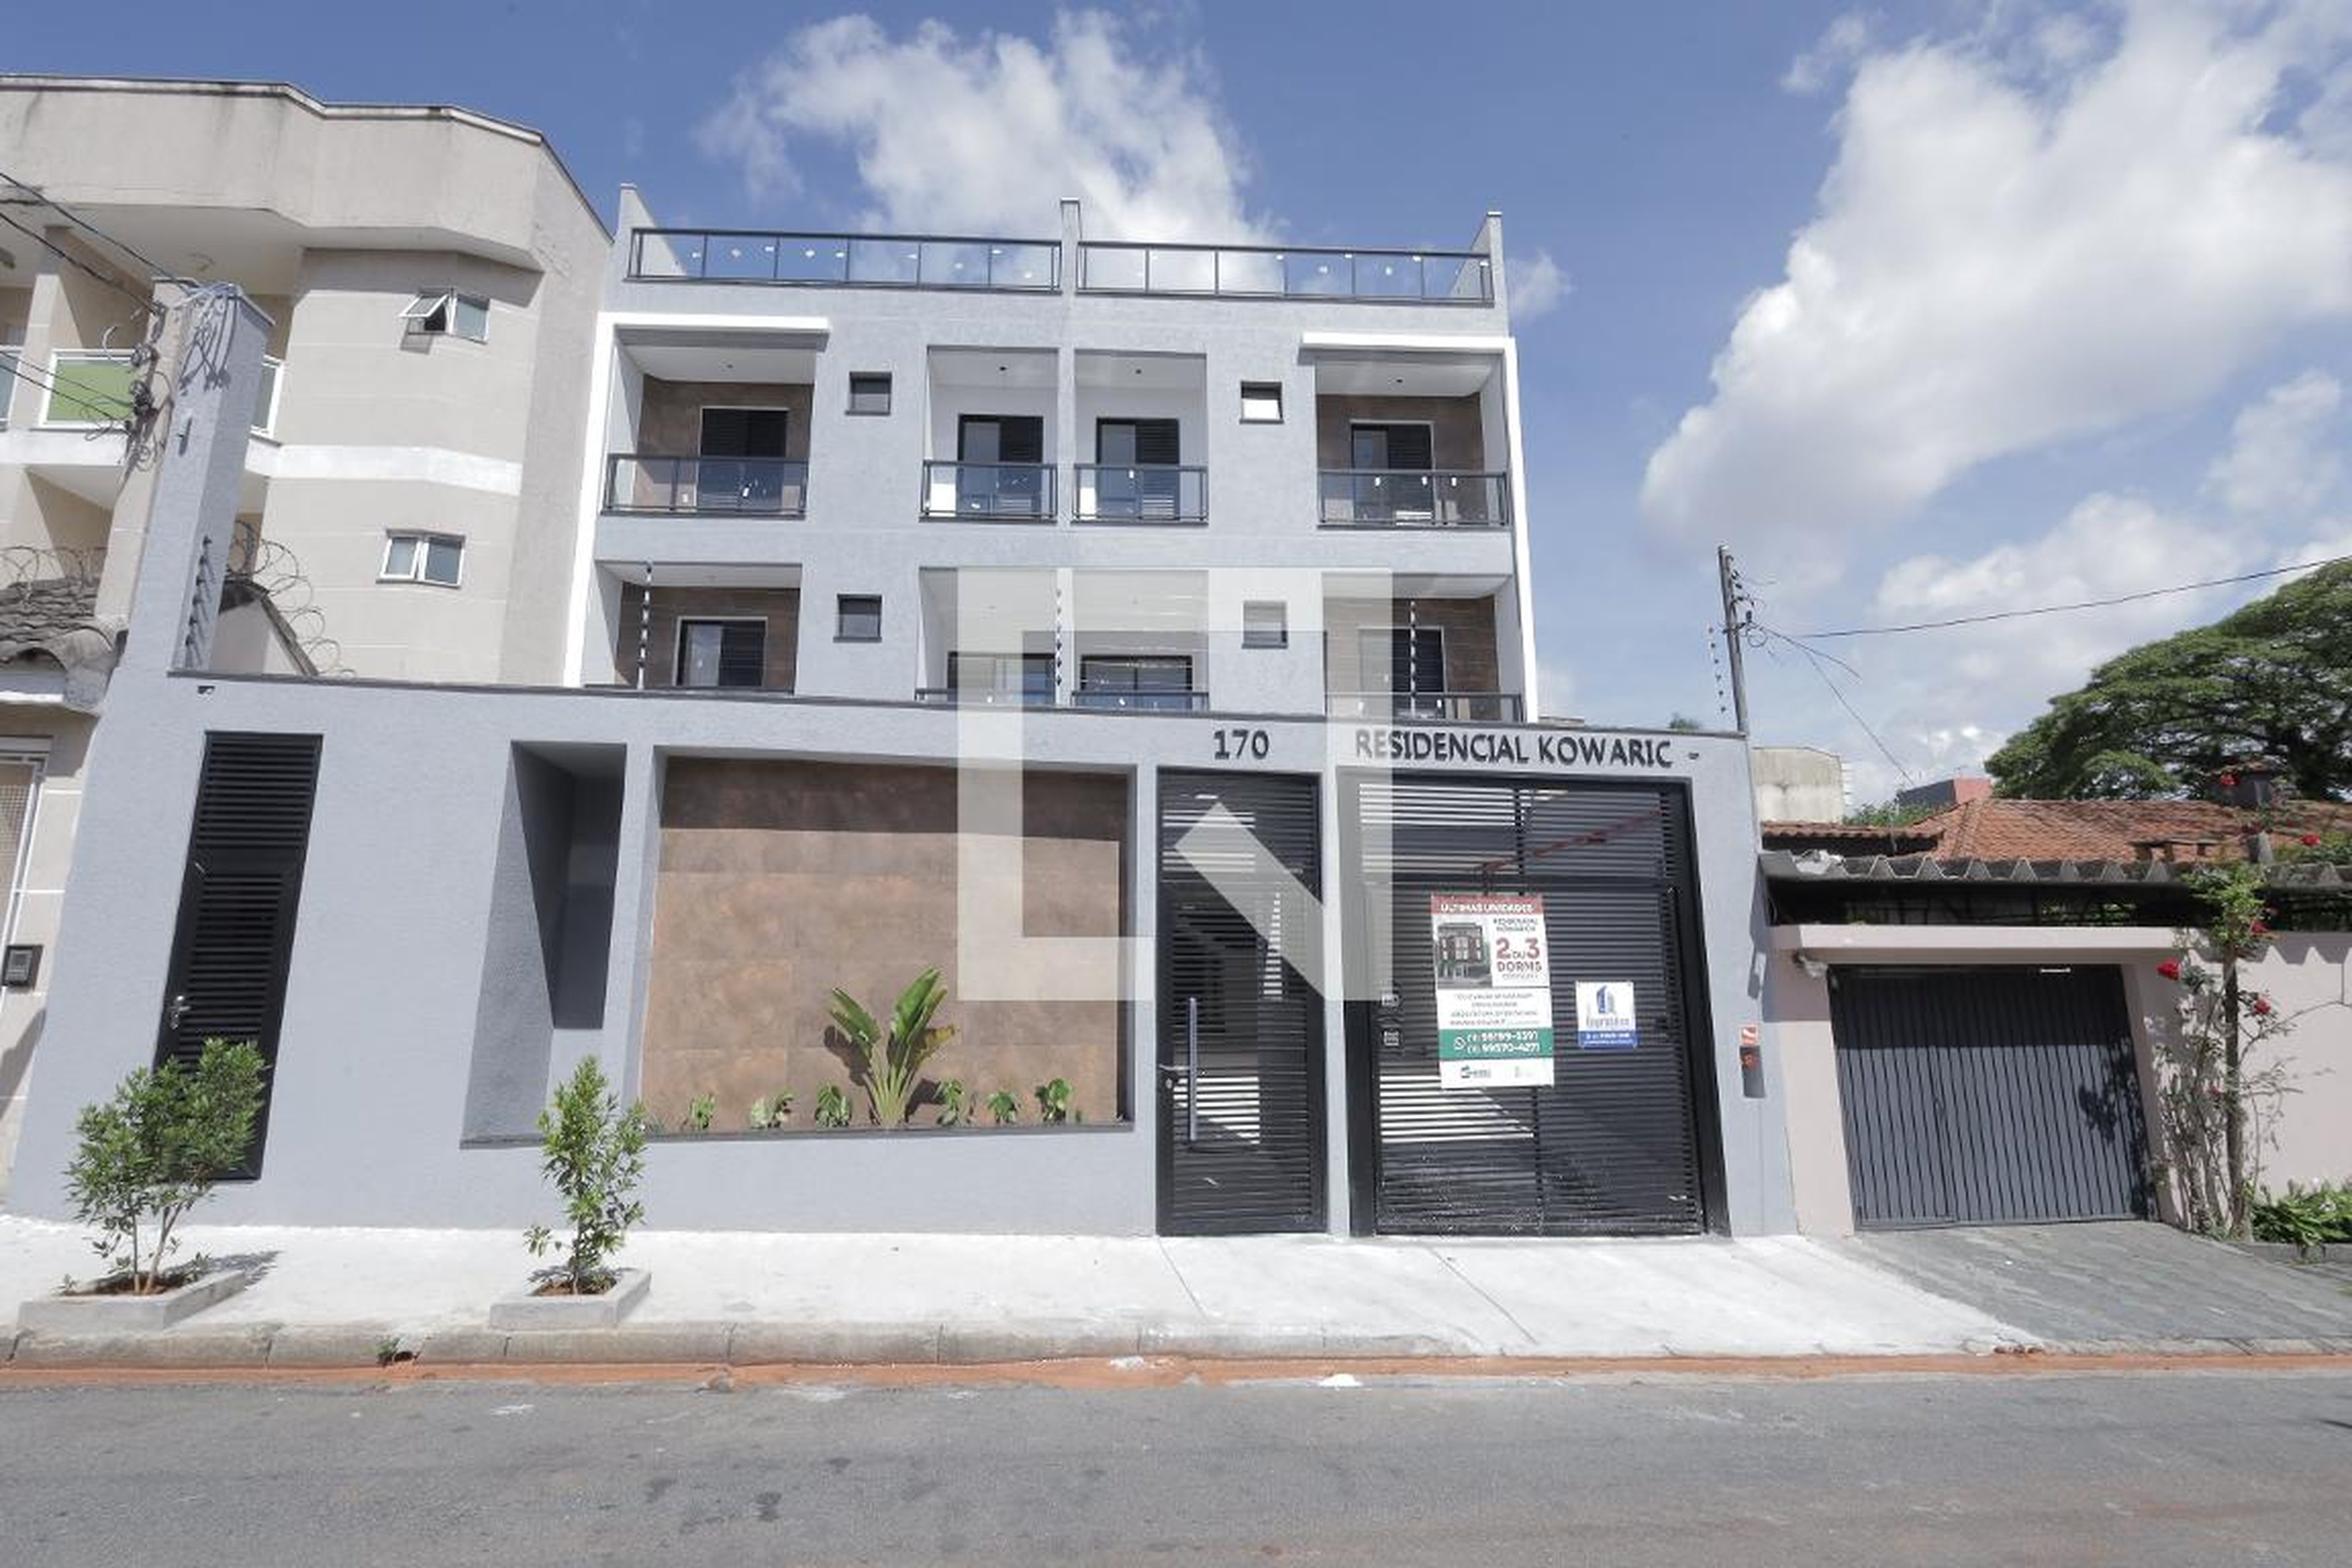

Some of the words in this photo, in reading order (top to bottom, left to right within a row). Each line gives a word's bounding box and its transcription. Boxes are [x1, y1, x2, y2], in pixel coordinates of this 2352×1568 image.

[1213, 728, 1269, 760] 170
[1355, 728, 1530, 763] RESIDENCIAL
[1537, 734, 1673, 768] KOWARIC
[1496, 937, 1511, 959] 2
[1525, 937, 1540, 959] 3
